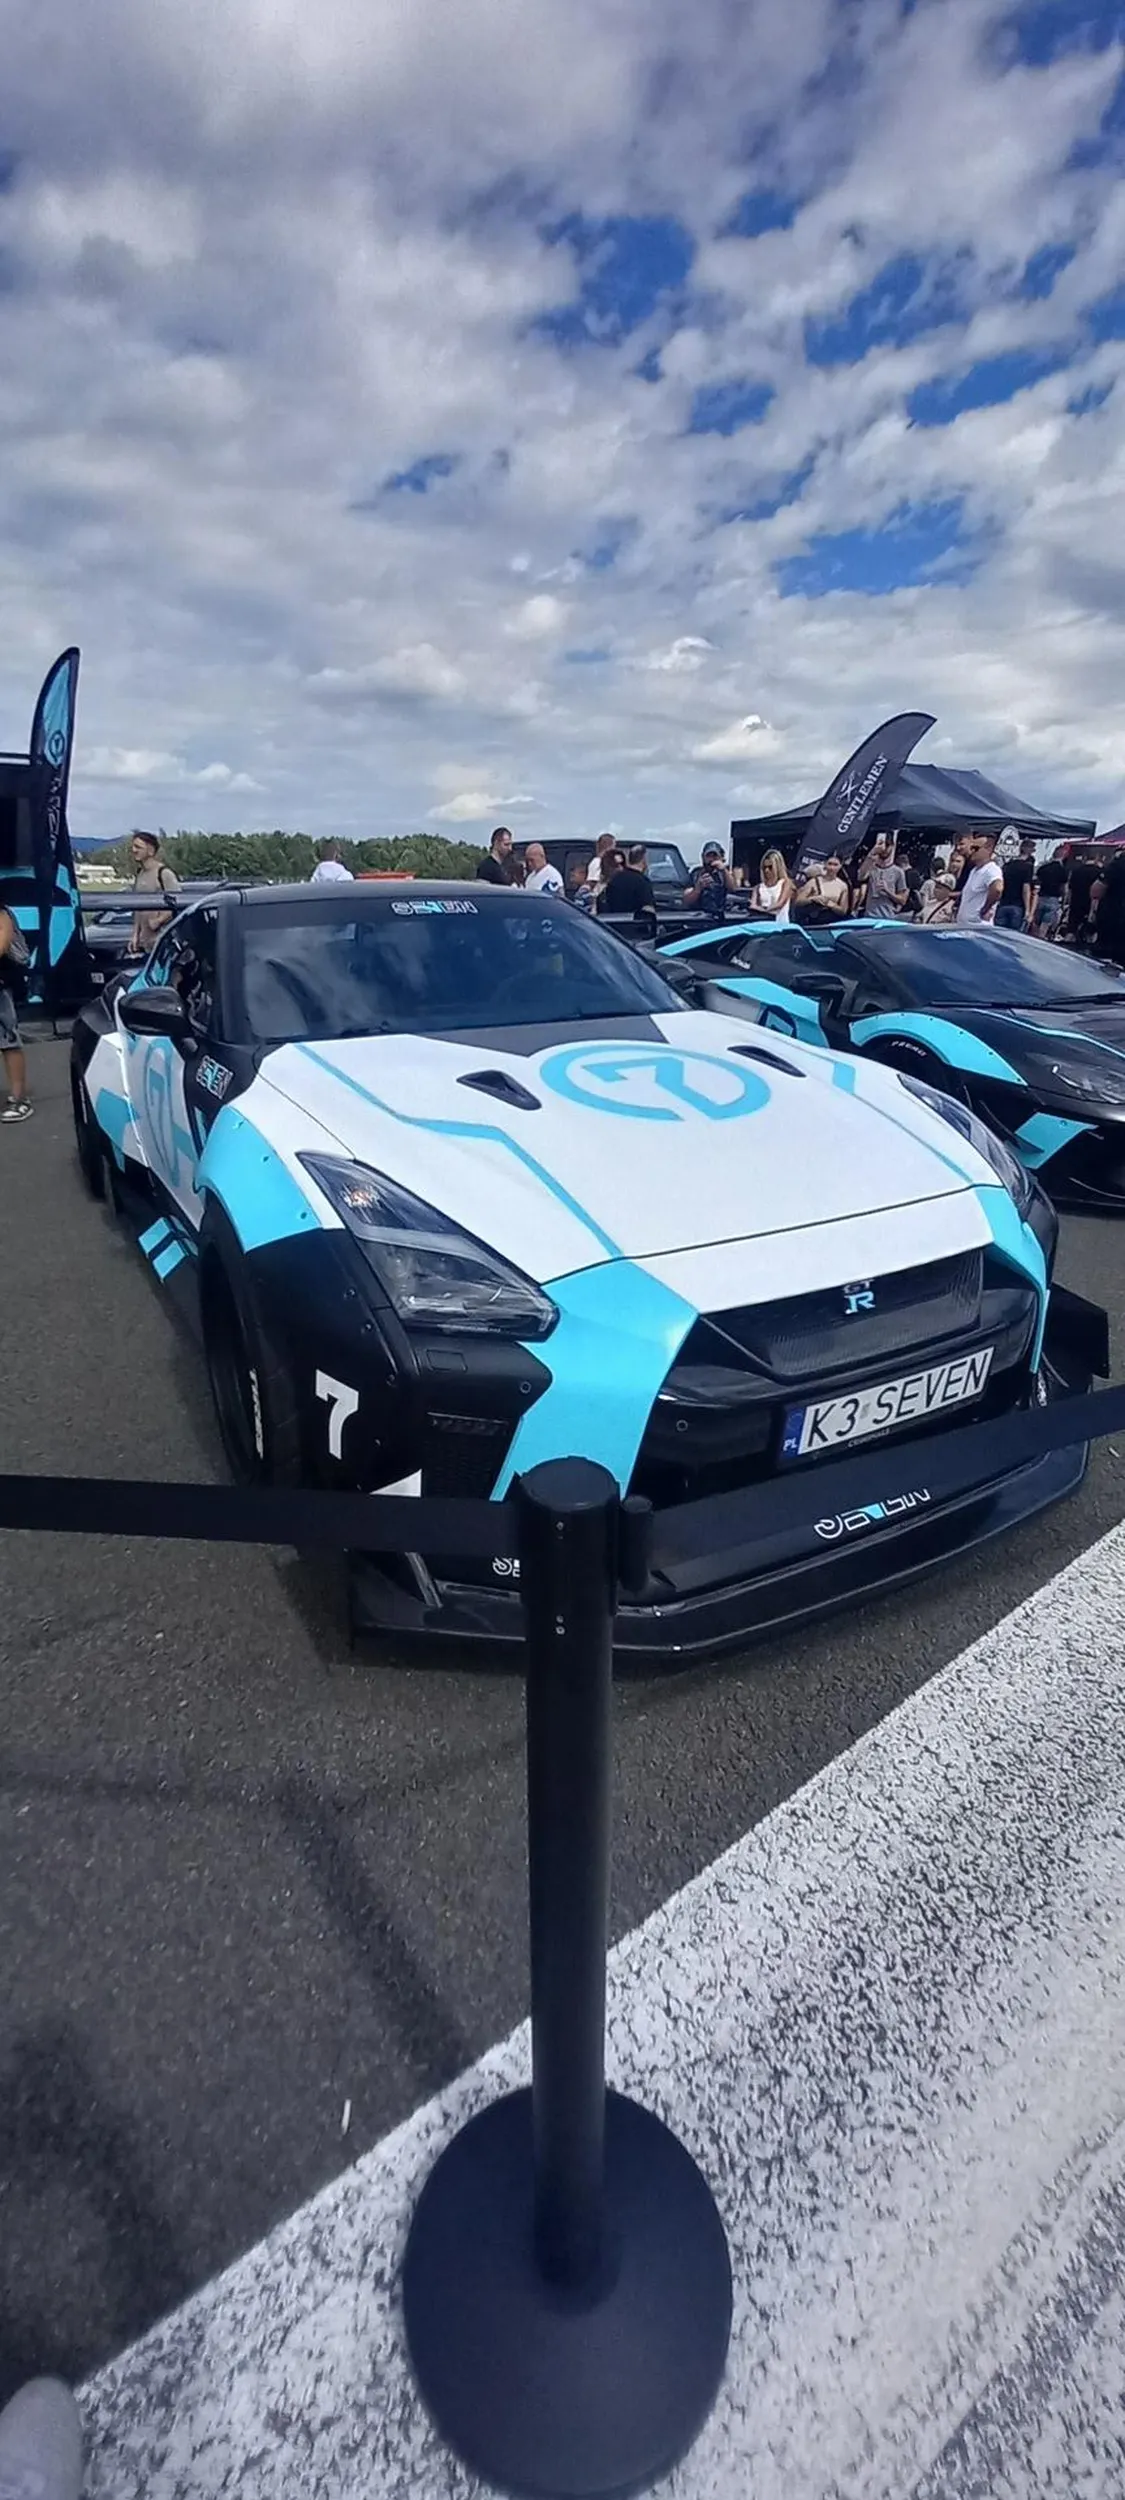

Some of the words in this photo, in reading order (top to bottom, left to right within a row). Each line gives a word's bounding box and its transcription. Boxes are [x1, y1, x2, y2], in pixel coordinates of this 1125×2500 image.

[837, 754, 887, 833] GENTLEMEN
[315, 1368, 359, 1460] 7
[807, 1397, 859, 1447] K3
[873, 1352, 989, 1425] SEVEN
[783, 1439, 798, 1451] PL
